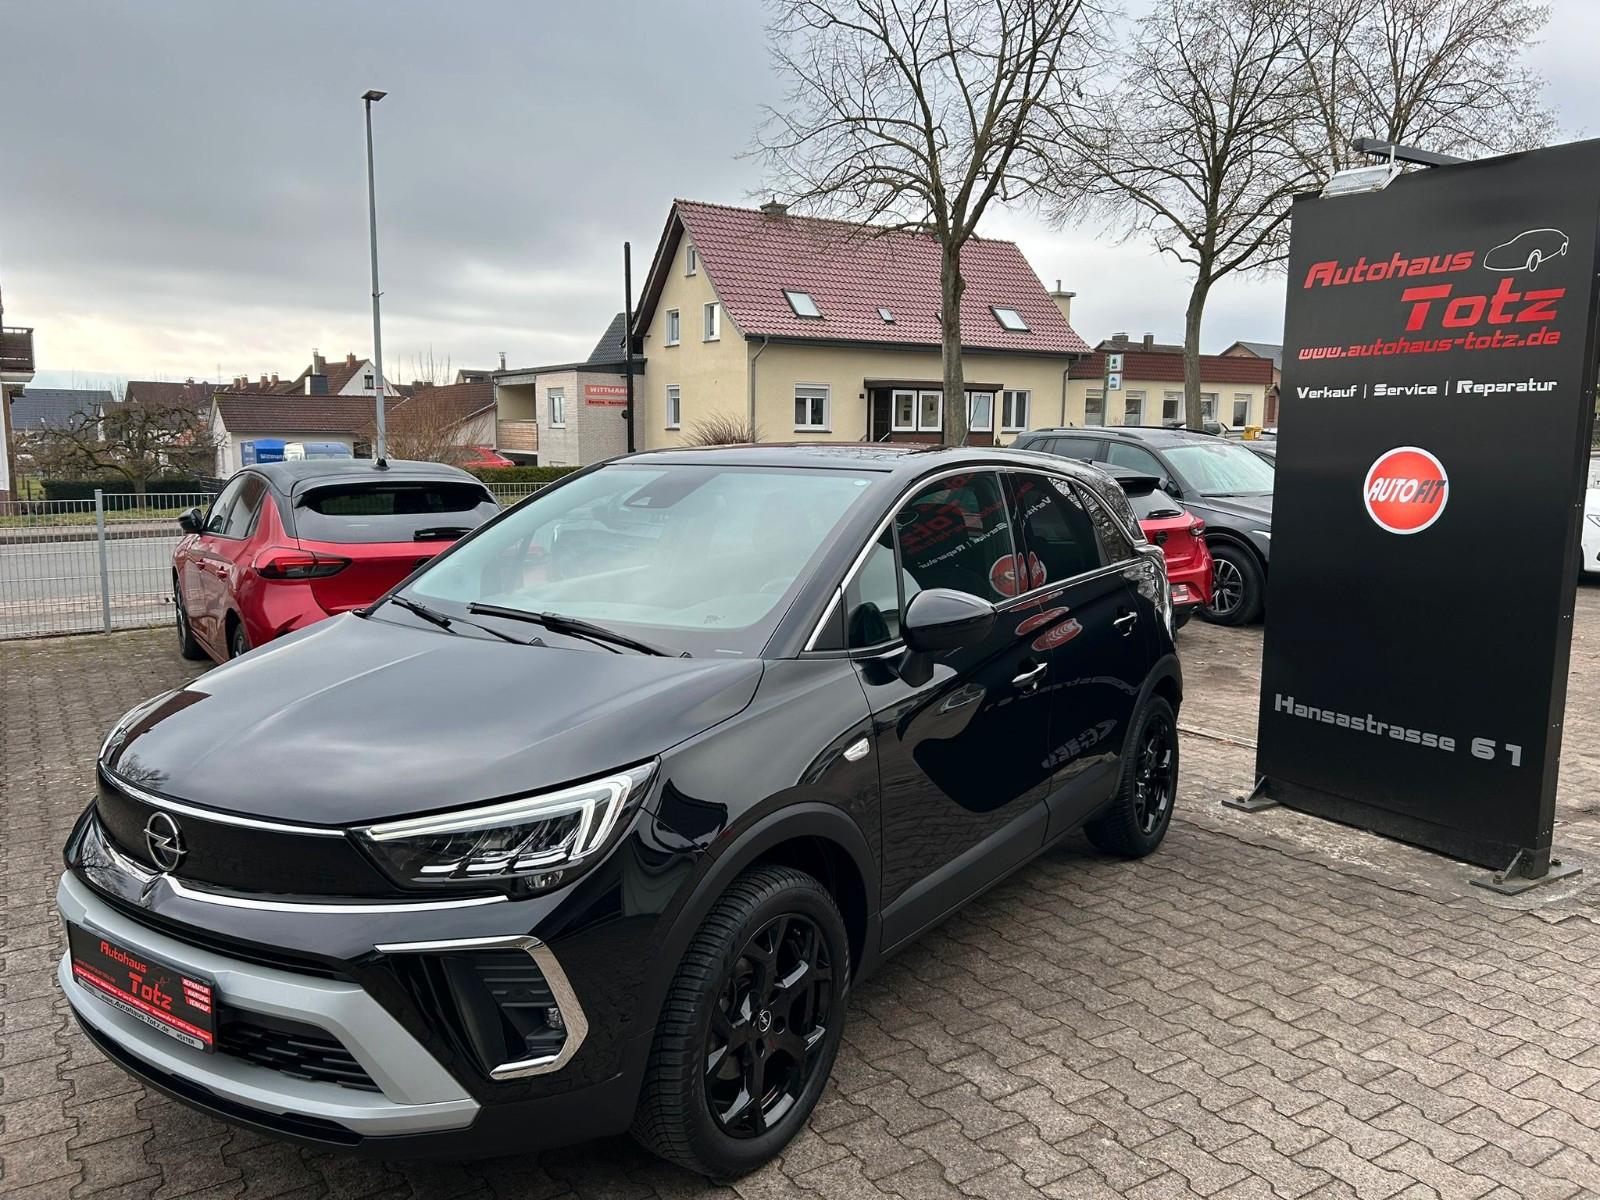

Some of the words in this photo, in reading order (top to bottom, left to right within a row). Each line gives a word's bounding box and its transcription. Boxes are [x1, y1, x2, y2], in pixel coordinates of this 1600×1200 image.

[1303, 250, 1475, 289] Autohaus
[1400, 277, 1566, 331] Totz
[1298, 326, 1561, 360] www.autohaus-totz.de
[1297, 384, 1358, 399] Verkauf
[1373, 382, 1438, 397] Service
[1456, 378, 1558, 396] Reparatur
[1368, 477, 1447, 504] AUTOFIT
[1274, 693, 1456, 752] Hansastrasse
[100, 940, 147, 974] Autohaus
[128, 971, 173, 1010] Totz
